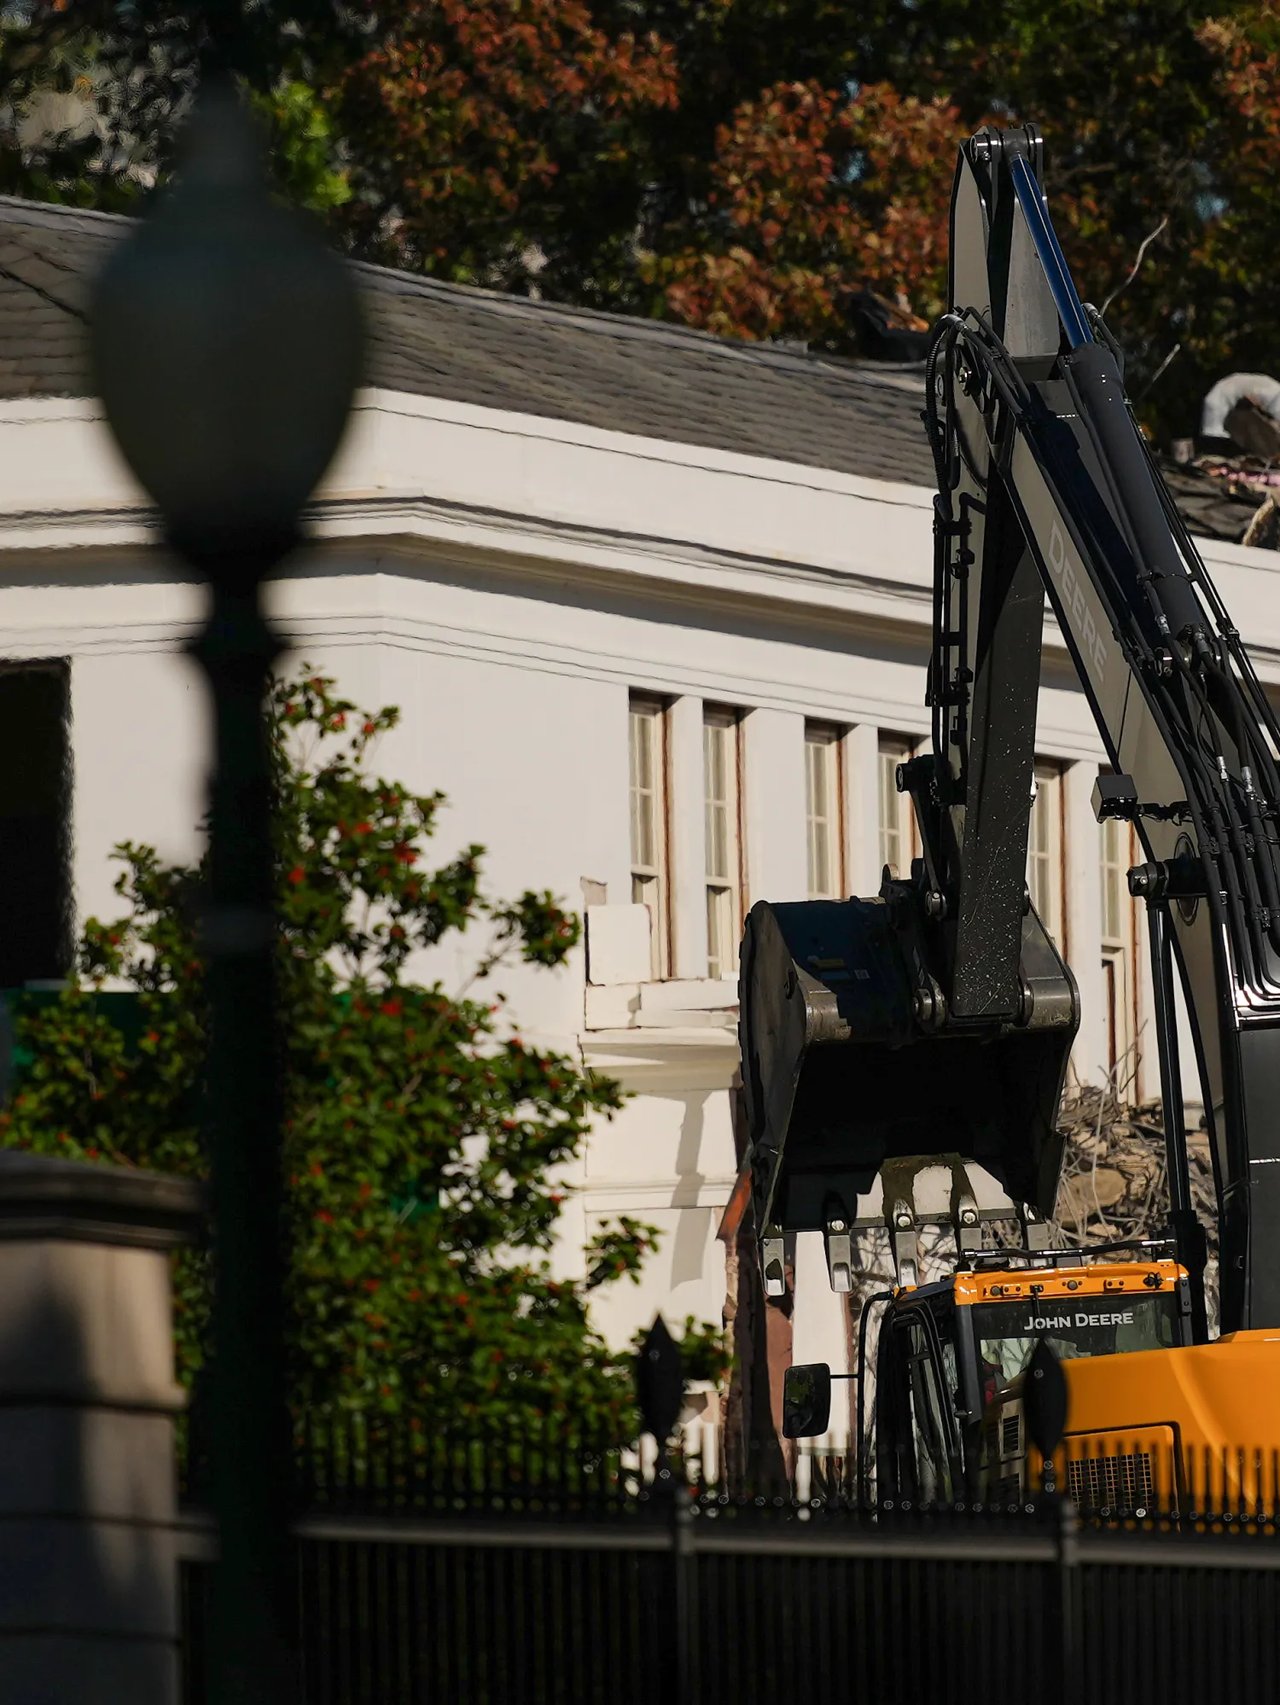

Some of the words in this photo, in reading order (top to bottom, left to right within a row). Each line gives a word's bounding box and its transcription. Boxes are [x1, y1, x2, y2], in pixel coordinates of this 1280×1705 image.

[1049, 520, 1107, 682] DEERE
[1023, 1316, 1071, 1330] JOHN
[1075, 1313, 1134, 1327] DEERE
